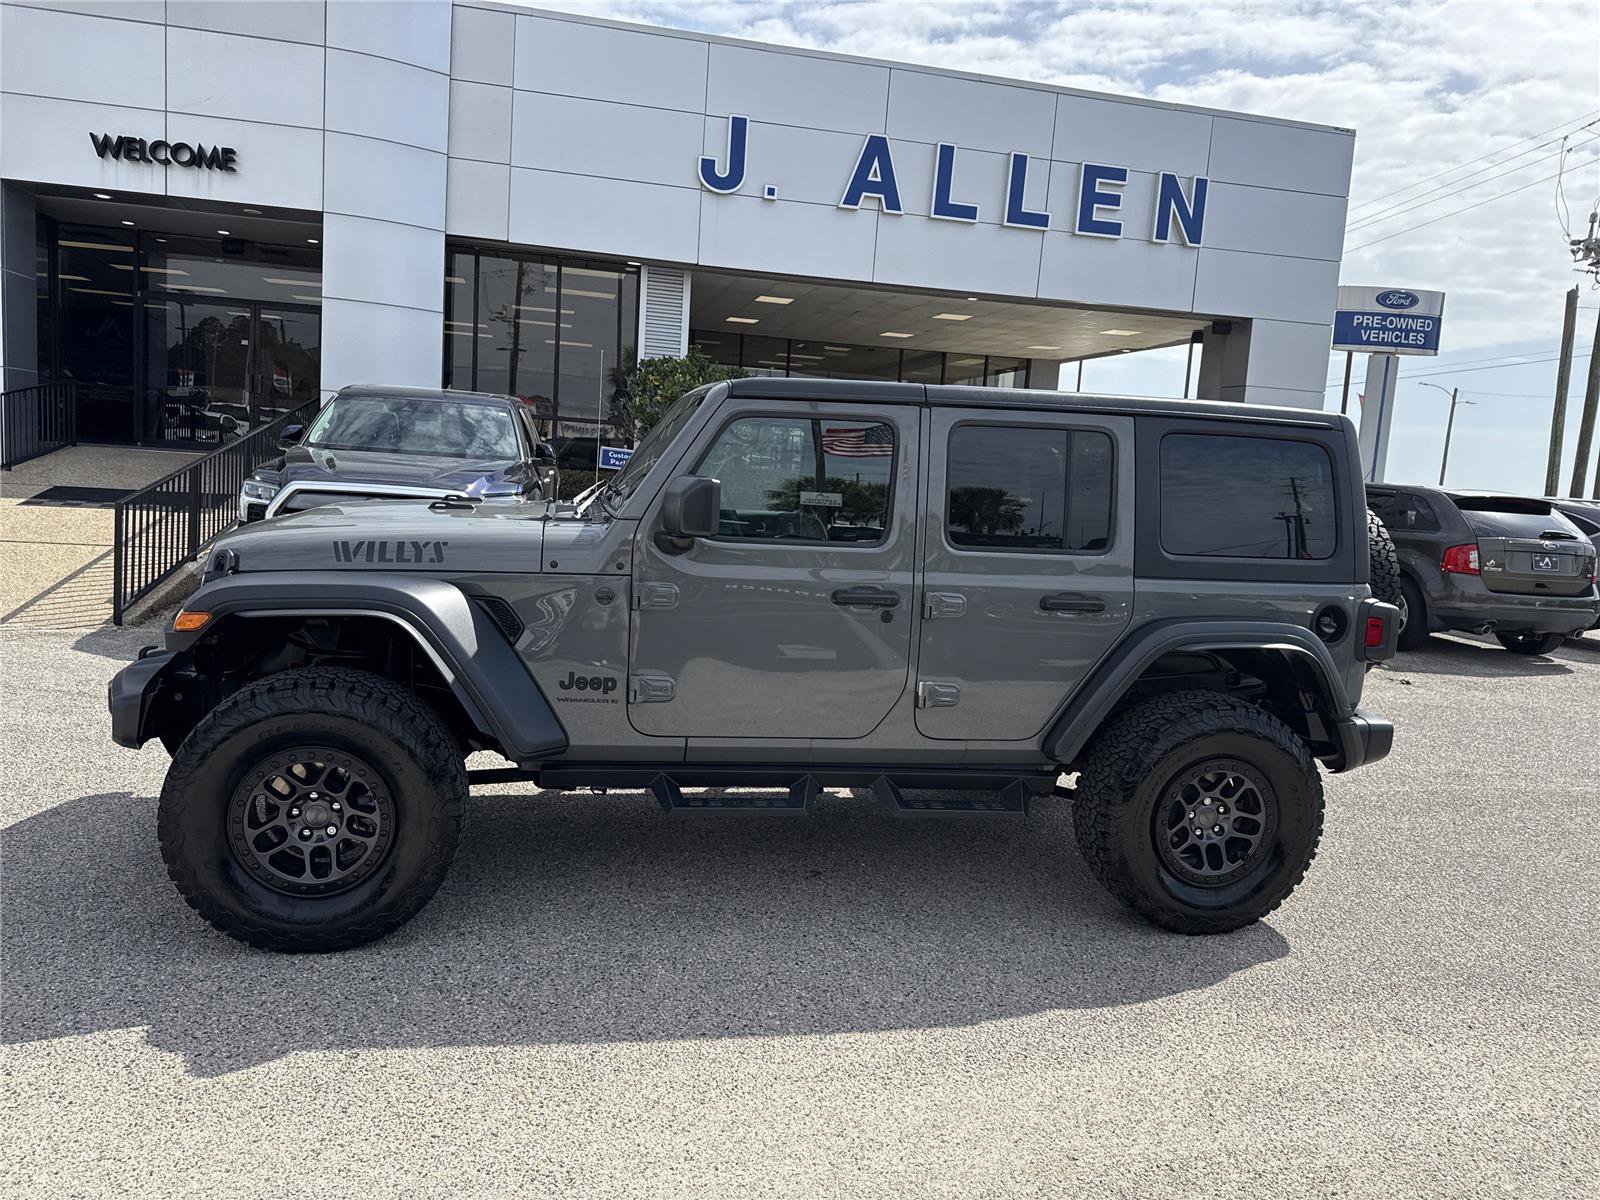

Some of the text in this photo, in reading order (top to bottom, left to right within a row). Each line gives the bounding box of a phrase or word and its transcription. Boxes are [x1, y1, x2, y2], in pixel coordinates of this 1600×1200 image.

[88, 131, 237, 173] WELCOME
[698, 114, 1209, 247] J. ALLEN
[1386, 292, 1412, 307] Ford
[1353, 315, 1433, 331] PRE-OWNED
[1361, 329, 1425, 345] VEHICLES
[608, 451, 631, 459] Custo
[333, 541, 449, 563] WILLYS
[559, 671, 618, 695] Jeep
